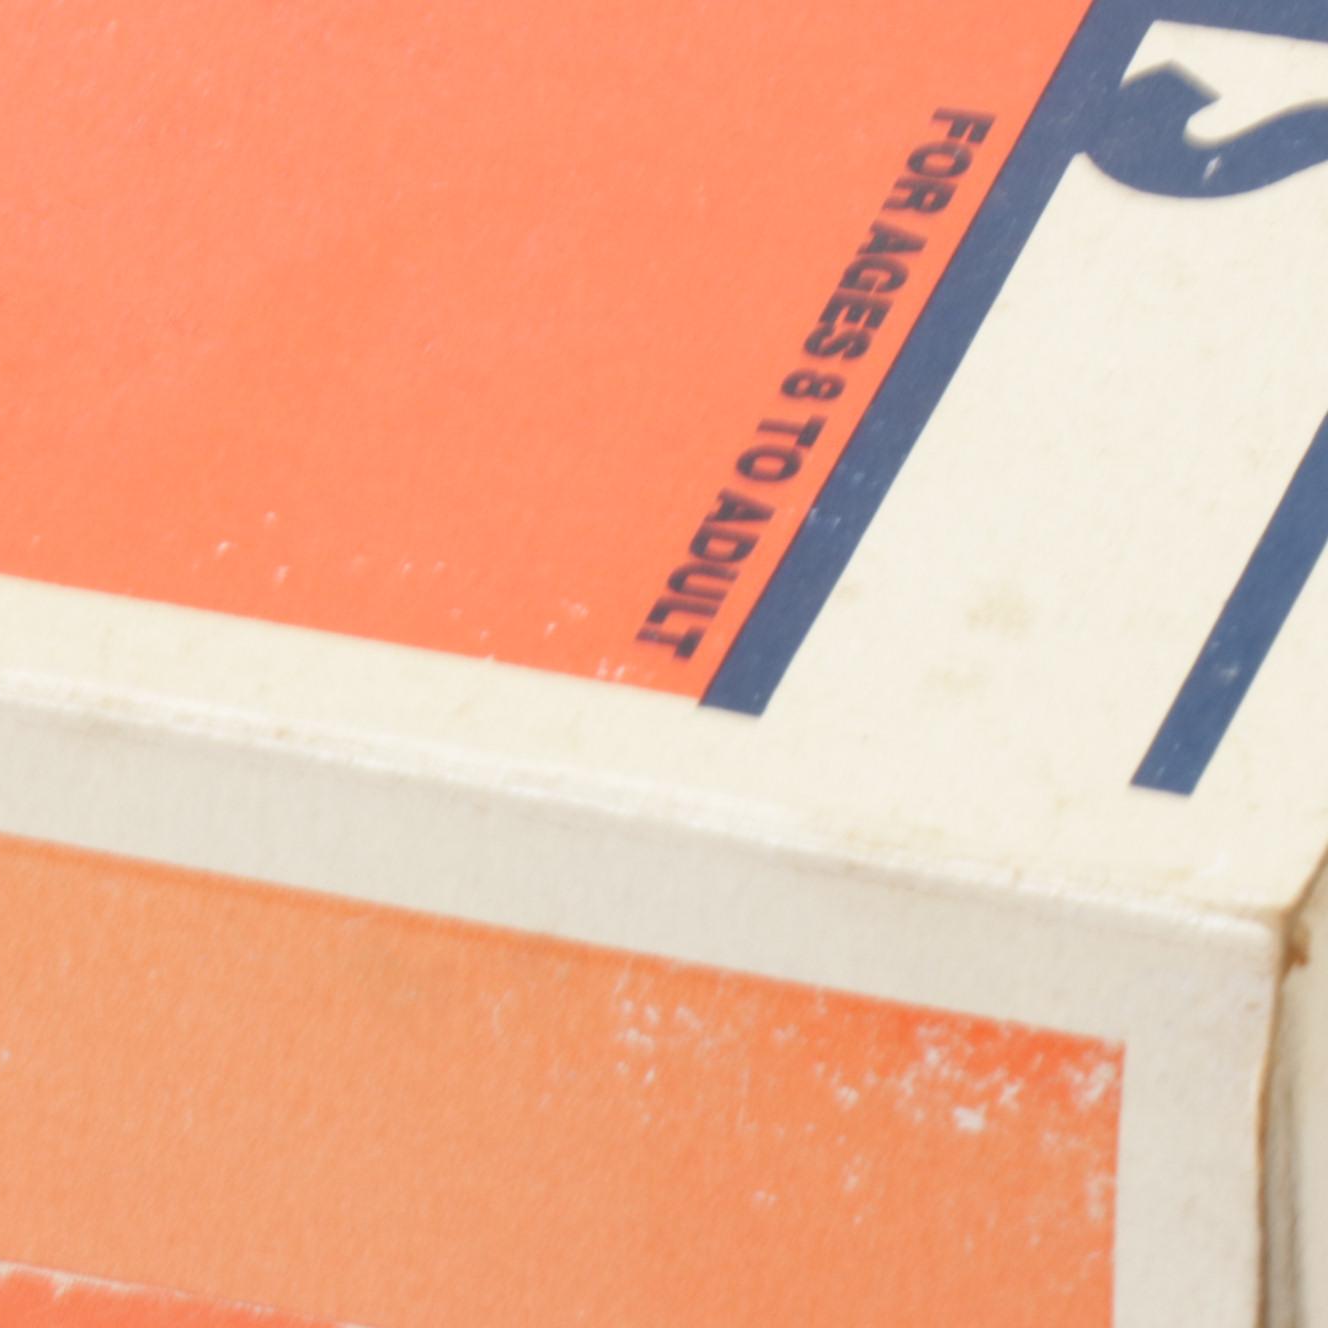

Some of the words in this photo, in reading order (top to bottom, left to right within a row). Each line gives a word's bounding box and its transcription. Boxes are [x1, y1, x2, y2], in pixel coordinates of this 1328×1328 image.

[878, 106, 996, 218] FOR
[802, 222, 928, 364] AGES
[779, 369, 847, 402] 8
[734, 416, 828, 485] TO
[634, 490, 775, 662] ADULT
